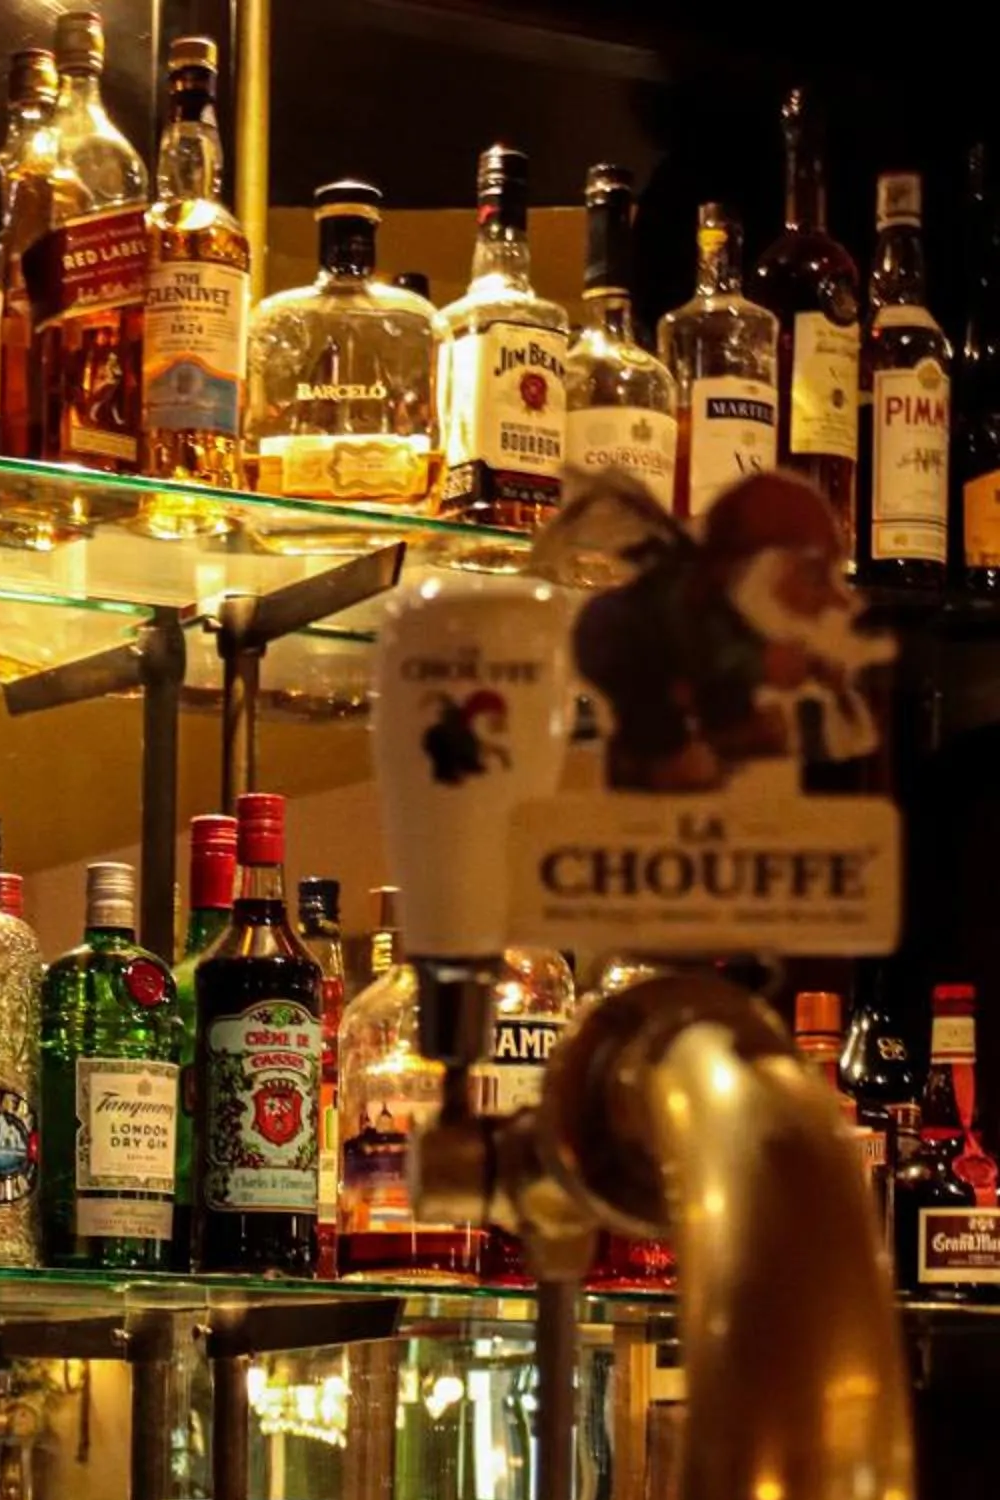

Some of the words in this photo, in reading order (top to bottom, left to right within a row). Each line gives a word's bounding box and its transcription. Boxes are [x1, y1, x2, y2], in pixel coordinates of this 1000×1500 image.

[62, 250, 98, 271] RED
[146, 286, 232, 308] GLENLIVET
[494, 345, 526, 377] JIM
[676, 813, 727, 842] LA
[539, 847, 870, 899] CHOUFFE
[489, 1027, 558, 1059] AMP
[111, 1122, 169, 1136] LONDON
[110, 1137, 142, 1148] DRY
